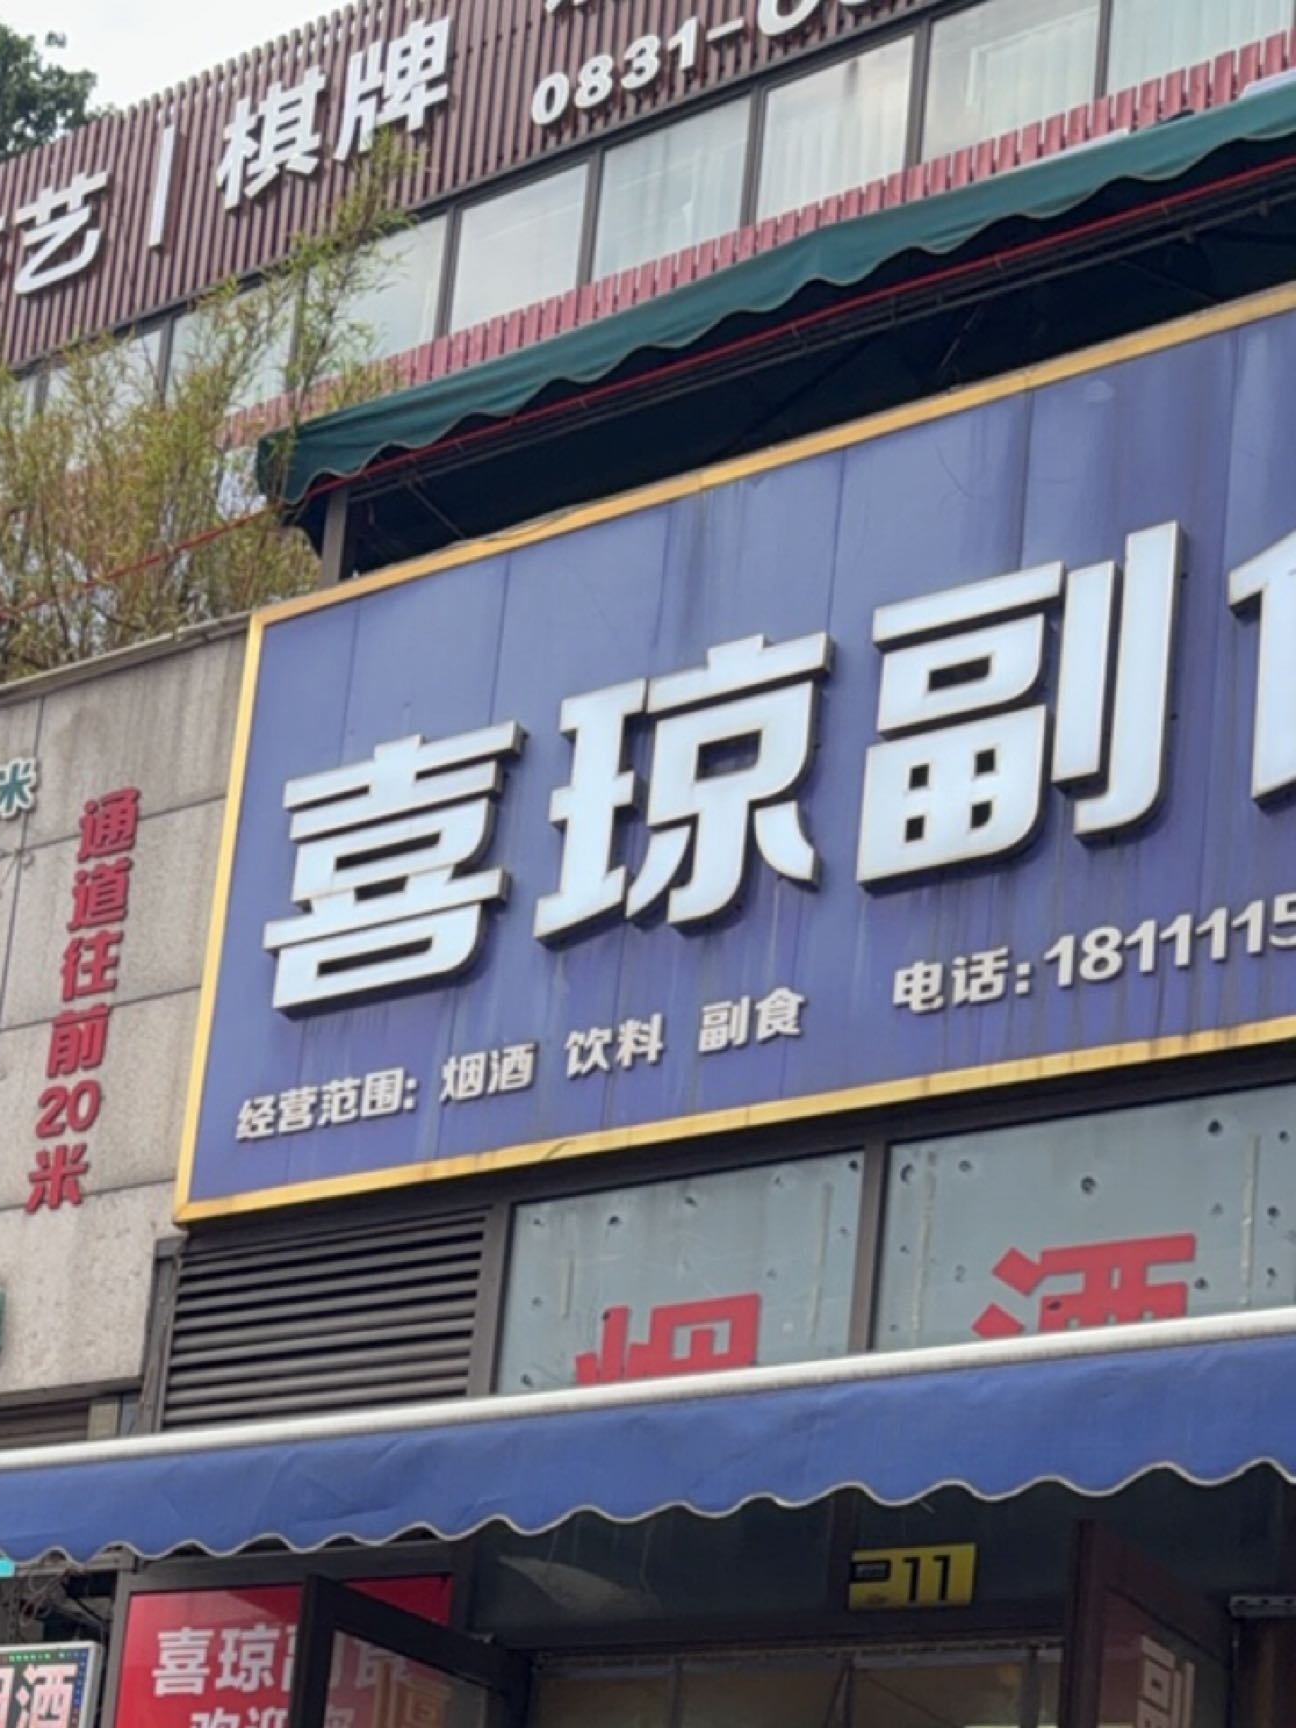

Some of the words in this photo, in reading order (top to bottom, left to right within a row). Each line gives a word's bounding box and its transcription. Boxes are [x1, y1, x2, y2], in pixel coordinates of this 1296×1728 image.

[215, 16, 452, 210] 棋牌
[531, 0, 871, 127] 0831-
[24, 786, 142, 1214] 通道往前20米
[439, 1042, 537, 1104] 烟酒
[564, 1011, 665, 1081] 饮料
[697, 987, 806, 1054] 副食
